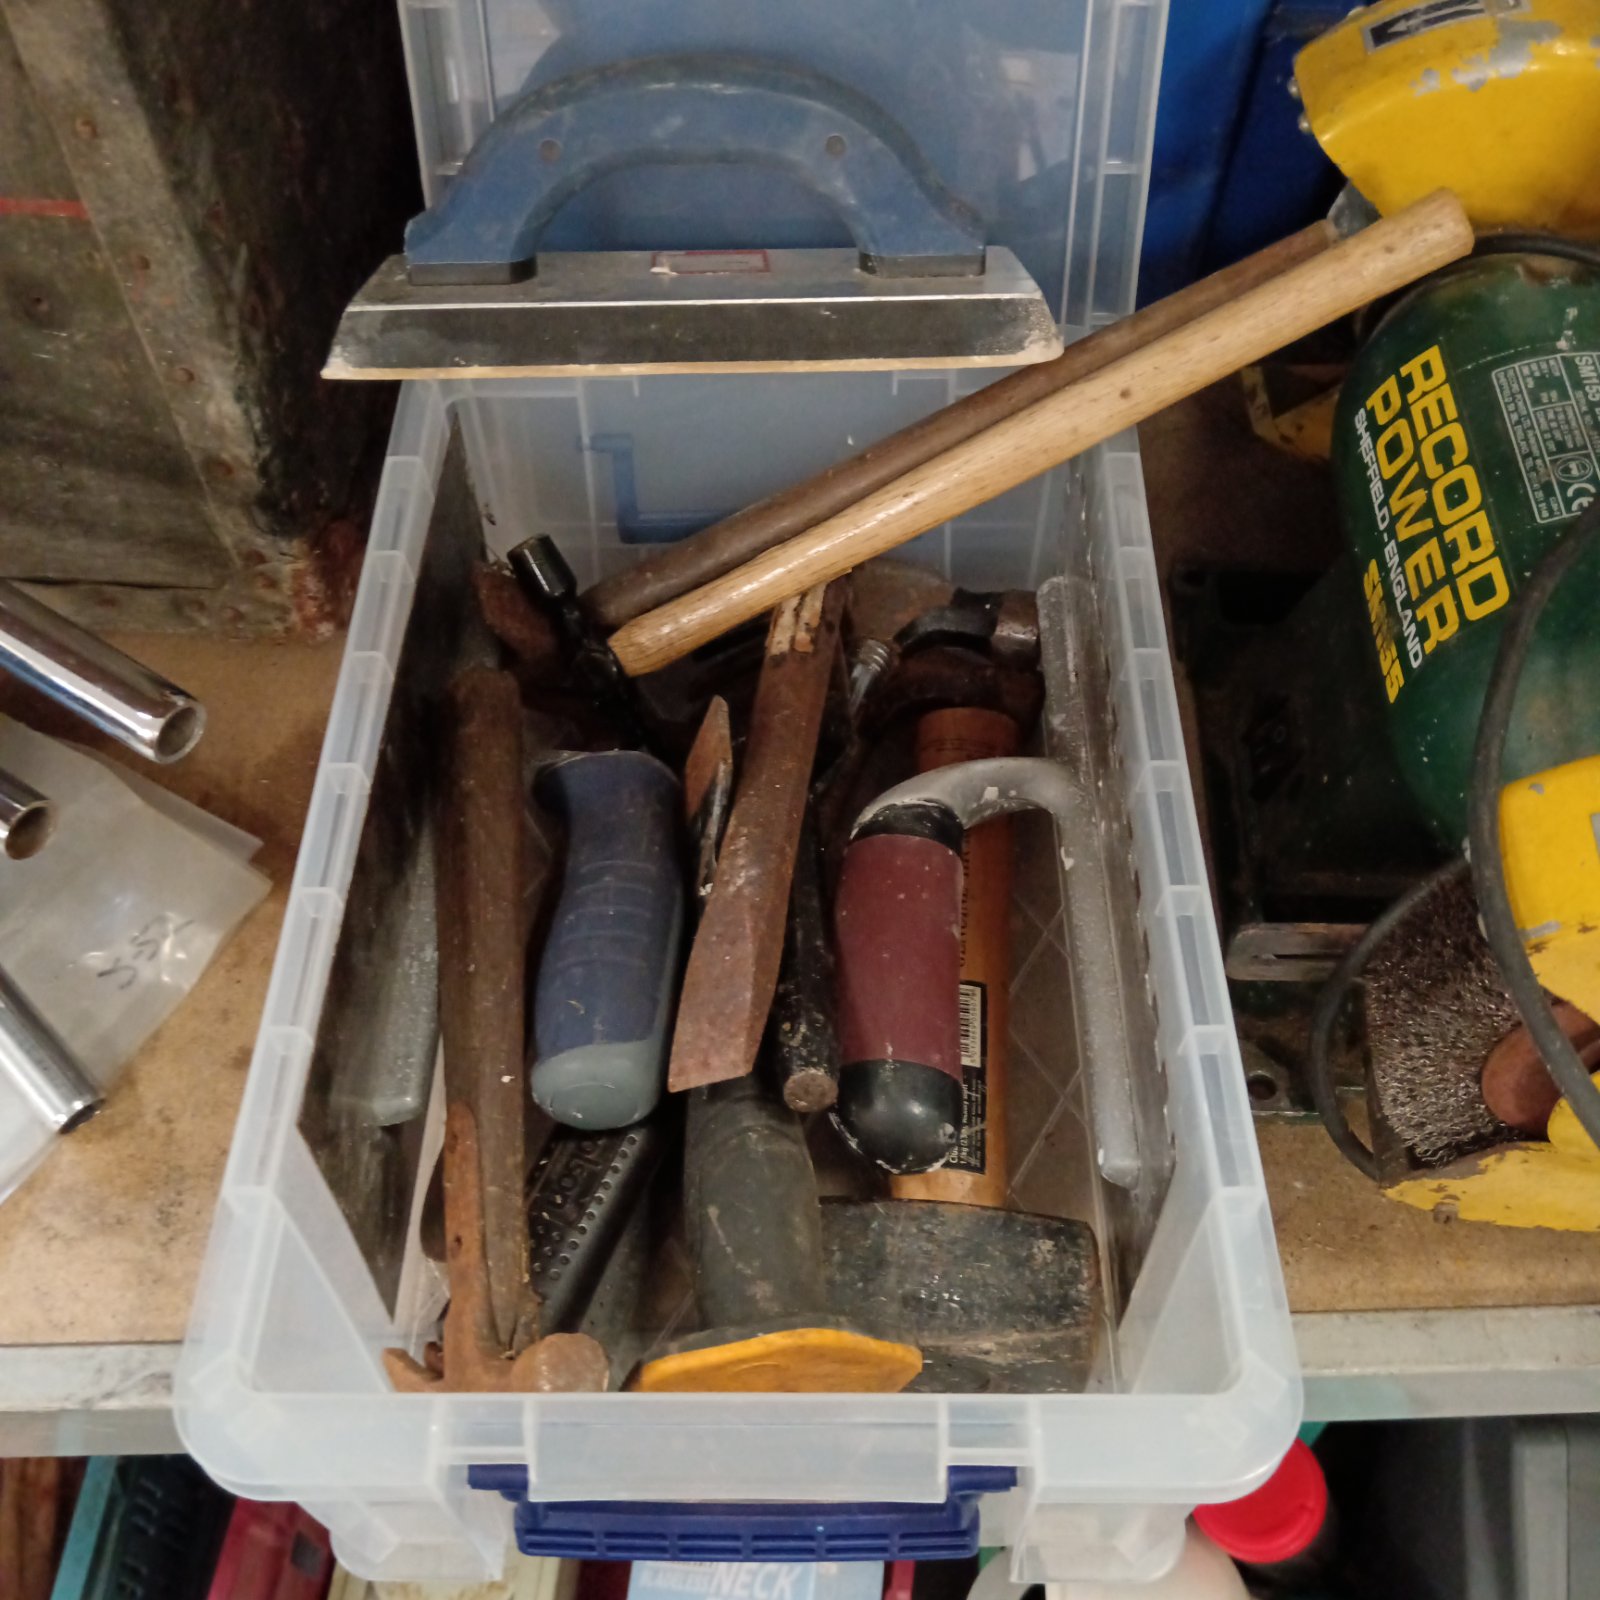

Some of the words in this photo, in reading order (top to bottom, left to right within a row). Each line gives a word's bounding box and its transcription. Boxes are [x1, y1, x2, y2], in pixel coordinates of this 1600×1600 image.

[1354, 408, 1390, 530] SHEFFIELD
[1384, 538, 1423, 669] ENGLAND
[1366, 374, 1460, 654] POWER
[1400, 345, 1510, 621] RECORD
[709, 1561, 802, 1599] NECK
